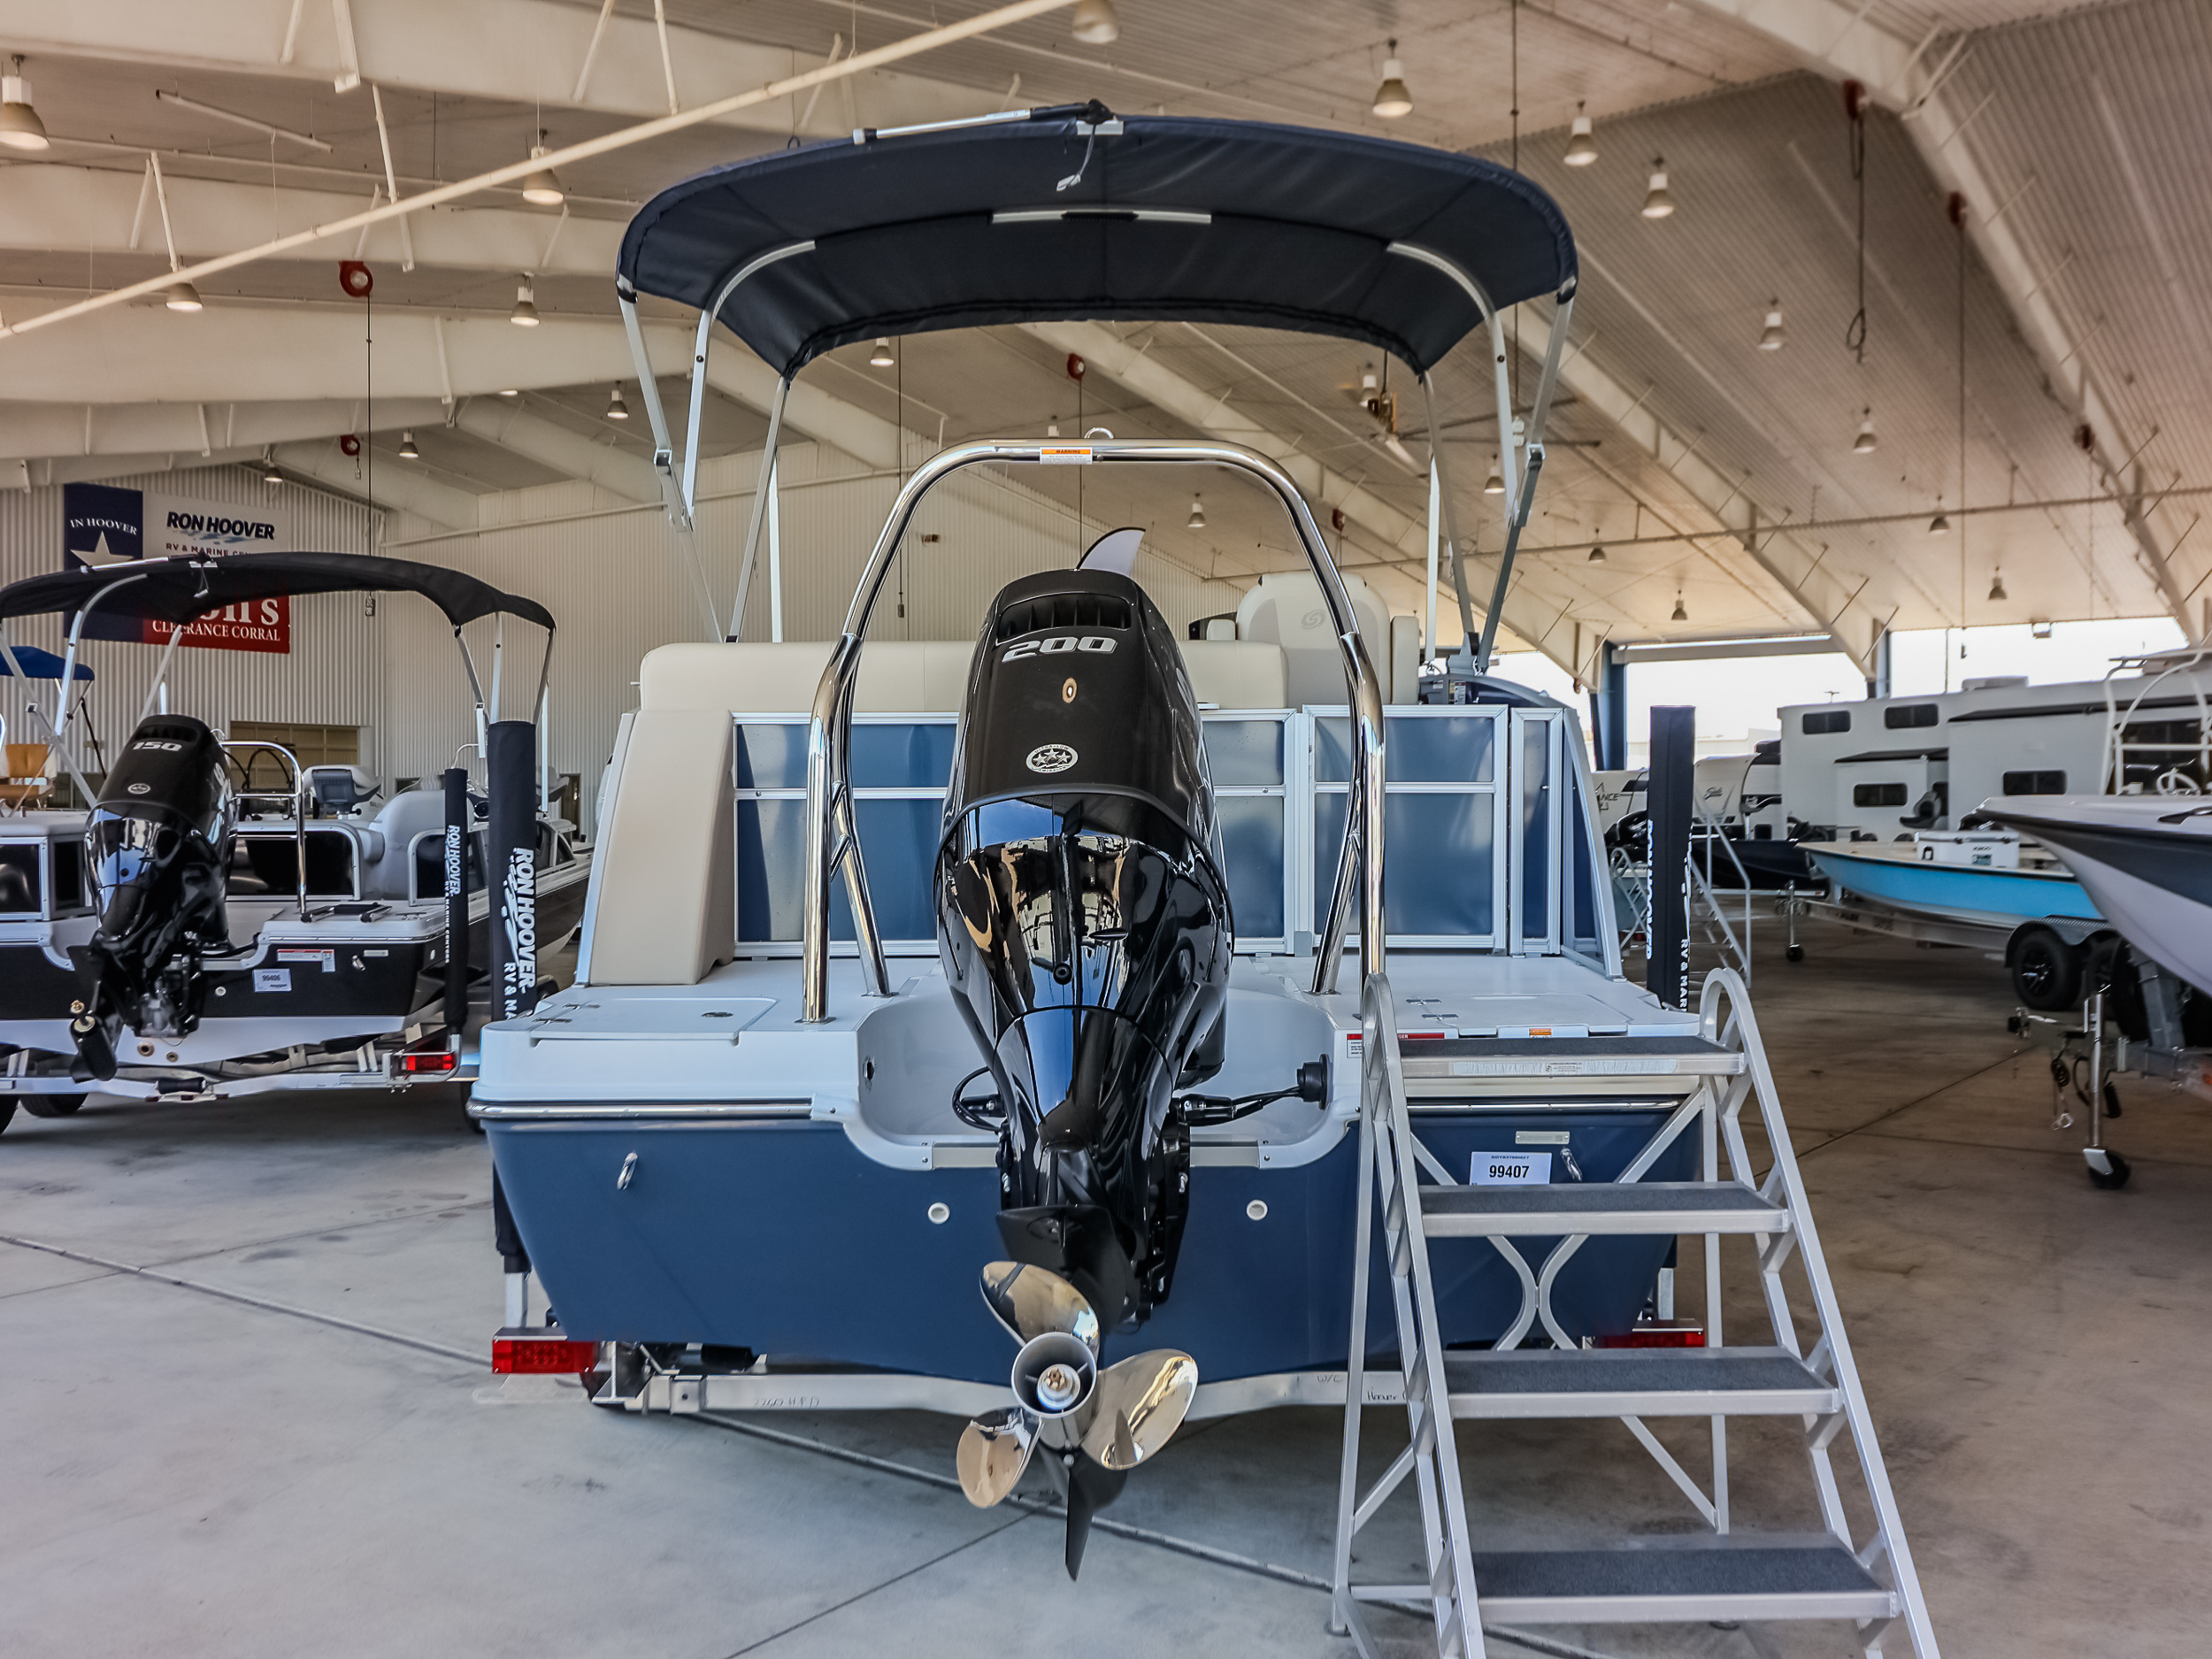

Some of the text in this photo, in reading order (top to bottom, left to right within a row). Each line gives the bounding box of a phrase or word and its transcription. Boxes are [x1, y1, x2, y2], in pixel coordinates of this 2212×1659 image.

[70, 518, 137, 535] IN HOOVER
[166, 511, 275, 540] RON HOOVER
[165, 542, 179, 551] RV
[231, 626, 280, 641] CORRAL
[1002, 636, 1118, 663] 200
[133, 741, 182, 752] 150
[449, 825, 461, 895] RON HOOVER
[516, 848, 536, 988] RON HOOVER
[1680, 939, 1689, 959] RV
[503, 962, 517, 982] RV
[504, 985, 518, 996] &
[1489, 1164, 1530, 1179] 99407
